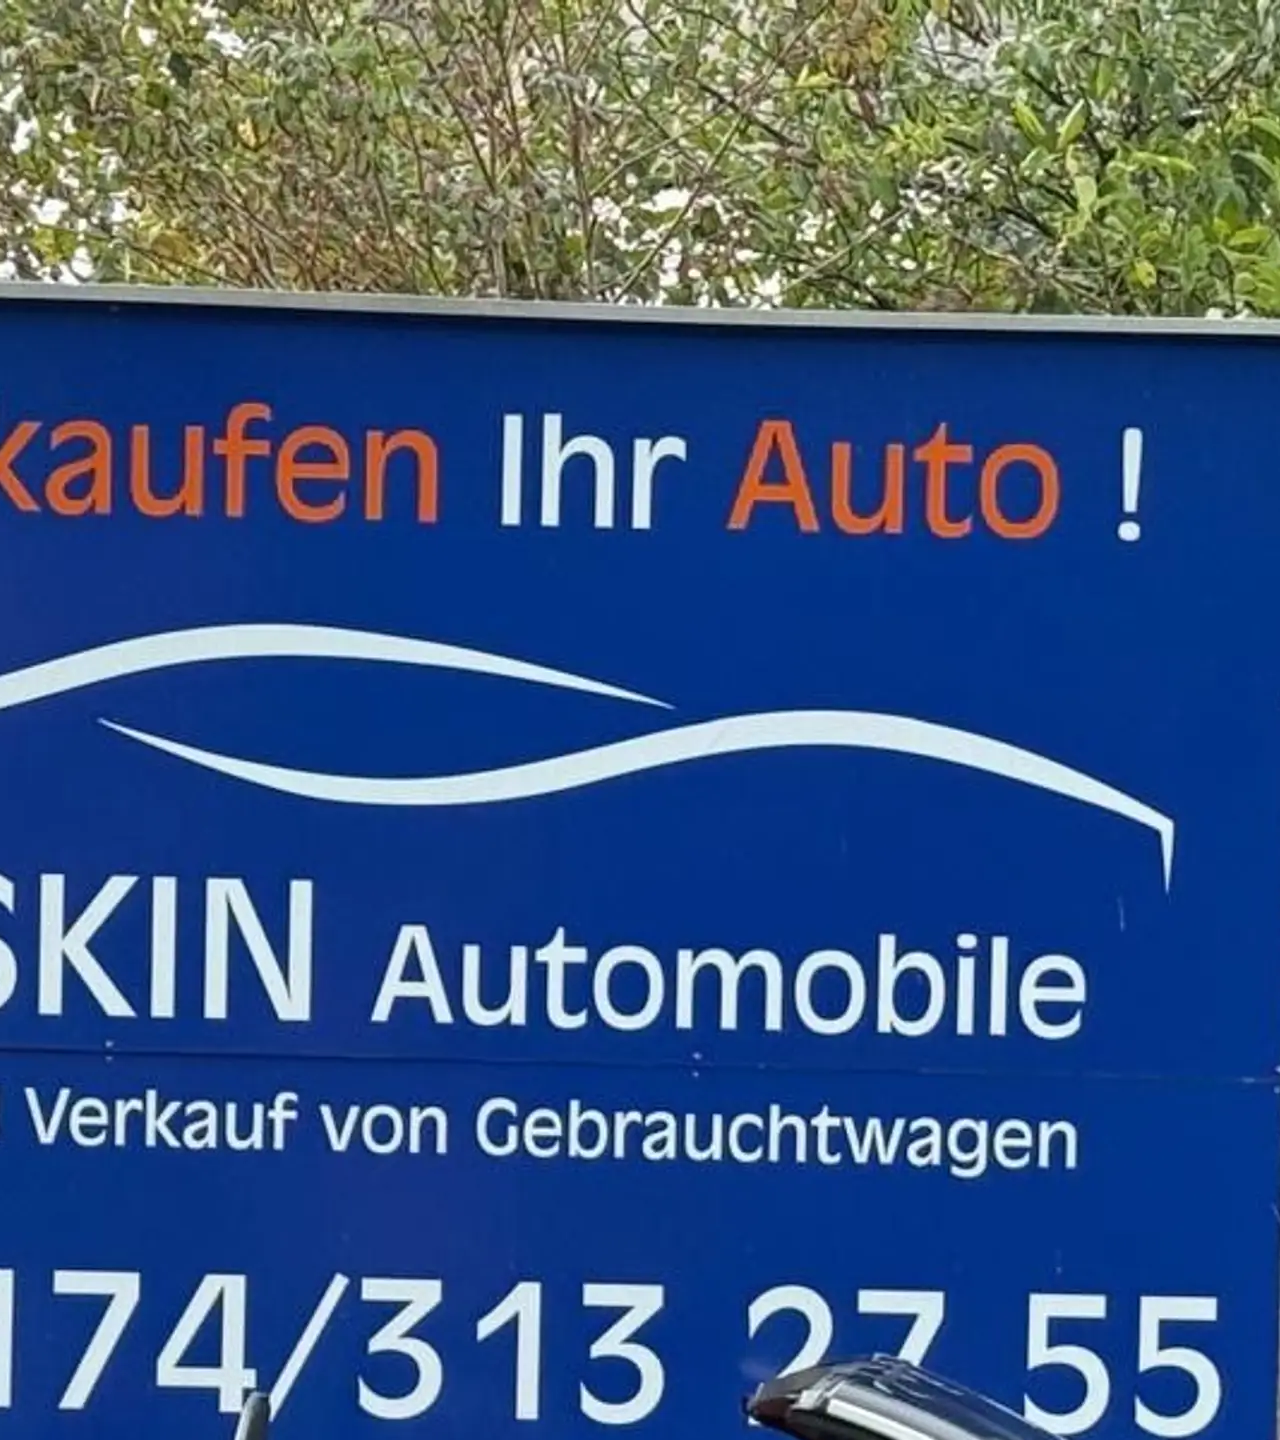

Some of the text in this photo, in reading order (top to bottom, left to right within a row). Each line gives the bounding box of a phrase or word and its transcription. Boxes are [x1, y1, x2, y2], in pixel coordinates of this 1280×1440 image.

[501, 413, 687, 529] Ihr
[728, 421, 1058, 538] Auto
[1118, 427, 1143, 541] !
[371, 924, 1086, 1039] Automobile
[25, 1088, 298, 1150] Verkauf
[319, 1104, 448, 1154] von
[476, 1097, 1077, 1178] Gebrauchtwagen
[1023, 1293, 1222, 1439] 55
